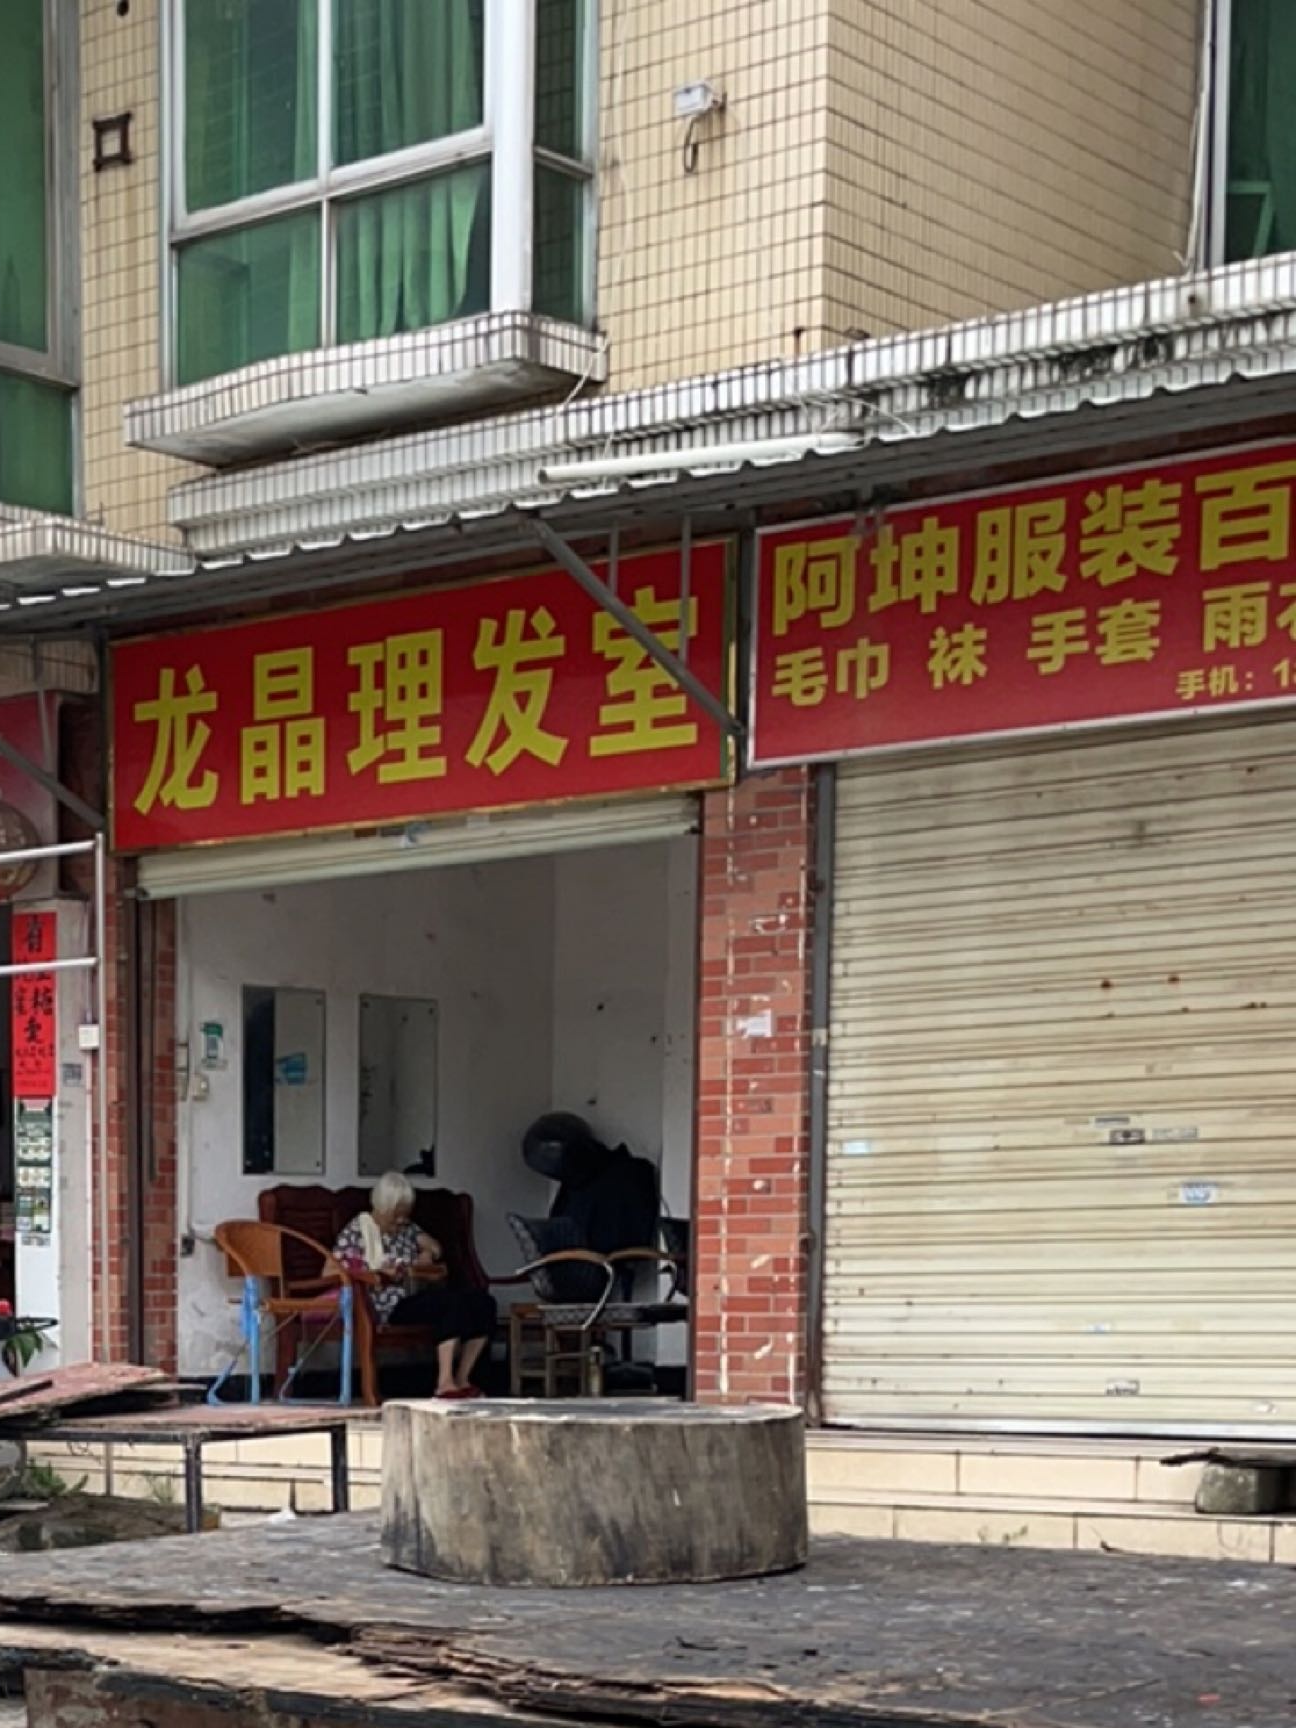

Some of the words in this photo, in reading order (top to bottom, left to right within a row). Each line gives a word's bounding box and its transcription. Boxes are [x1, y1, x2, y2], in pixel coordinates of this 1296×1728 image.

[772, 460, 1296, 636] 阿坤服装百
[134, 586, 698, 815] 龙晶理发室
[771, 637, 891, 708] 毛巾
[927, 622, 989, 690] 袜
[1026, 599, 1162, 676] 手套
